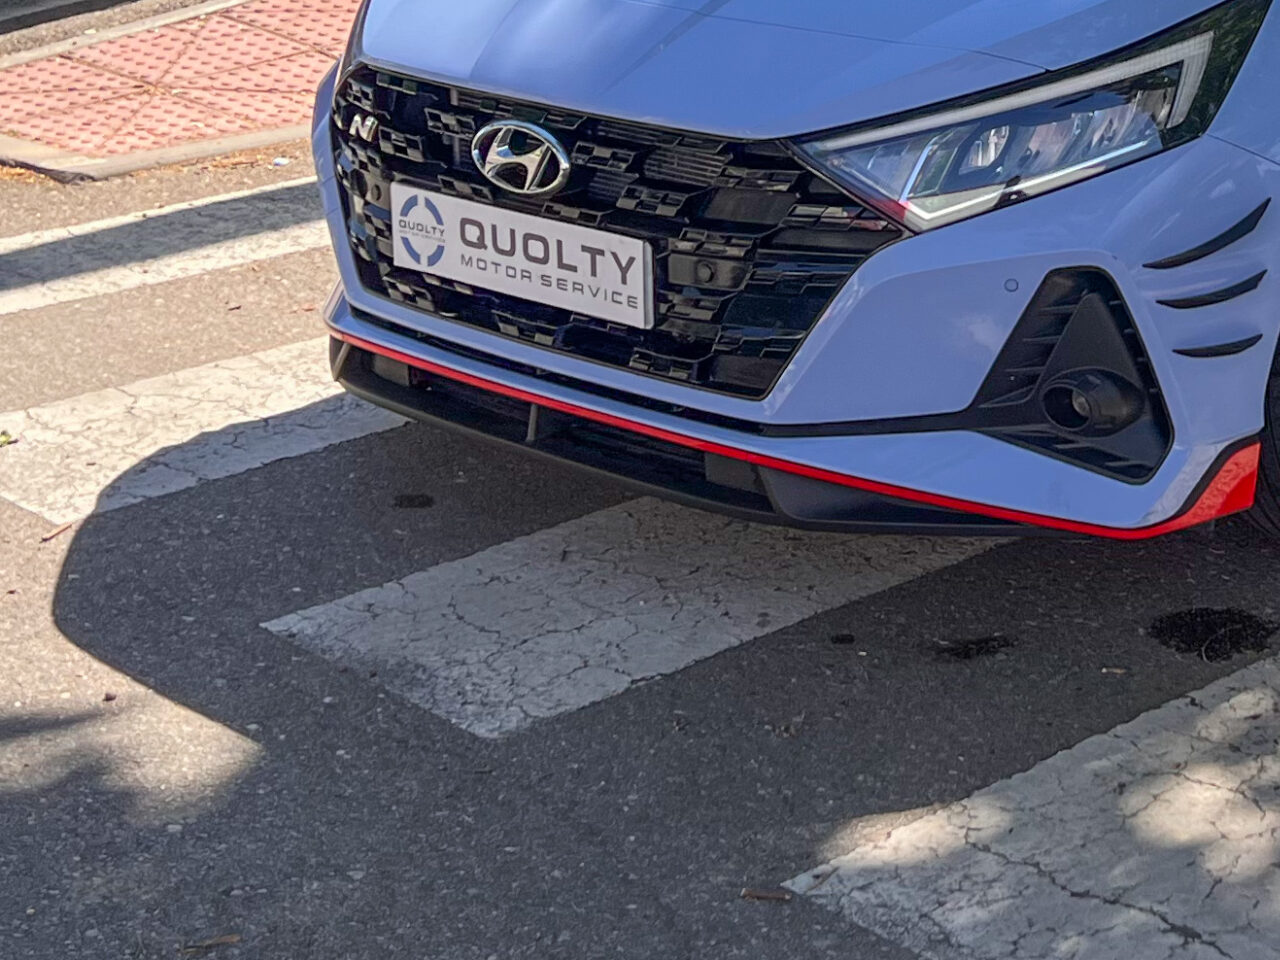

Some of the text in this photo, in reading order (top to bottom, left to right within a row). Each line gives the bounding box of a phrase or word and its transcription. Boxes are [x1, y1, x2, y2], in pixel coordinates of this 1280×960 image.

[349, 113, 379, 142] N
[398, 218, 445, 237] QUOLTY
[459, 217, 636, 286] QUOLTY
[460, 254, 639, 310] MOTOR SERVICE
